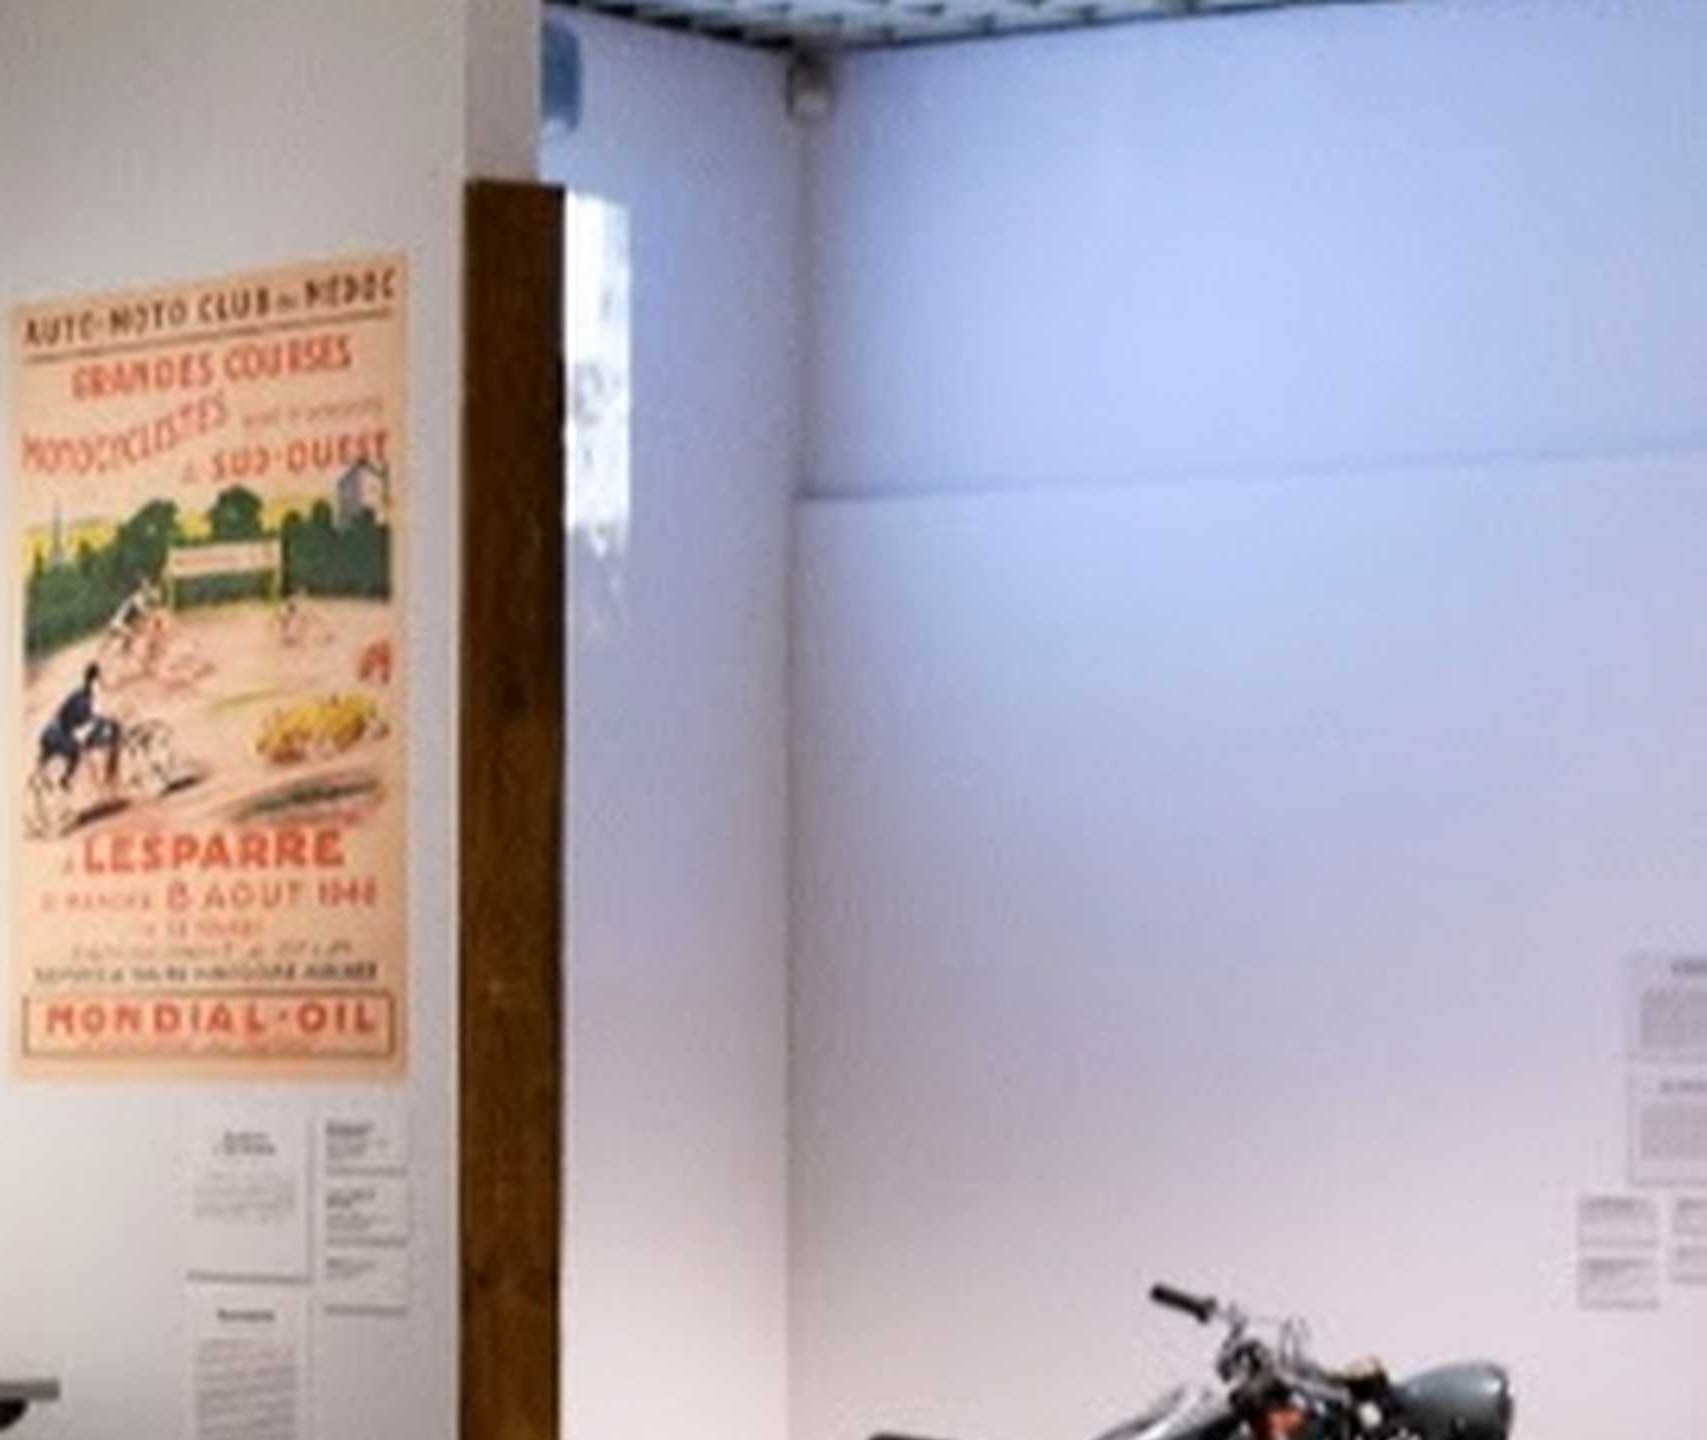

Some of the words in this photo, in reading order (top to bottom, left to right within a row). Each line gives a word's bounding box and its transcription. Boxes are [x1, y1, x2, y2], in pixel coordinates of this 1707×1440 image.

[197, 285, 272, 325] CLUB
[72, 349, 214, 399] GRANDES
[223, 332, 355, 382] COURSES
[210, 428, 390, 481] SUD-OUEST
[84, 828, 346, 874] LESPARRE
